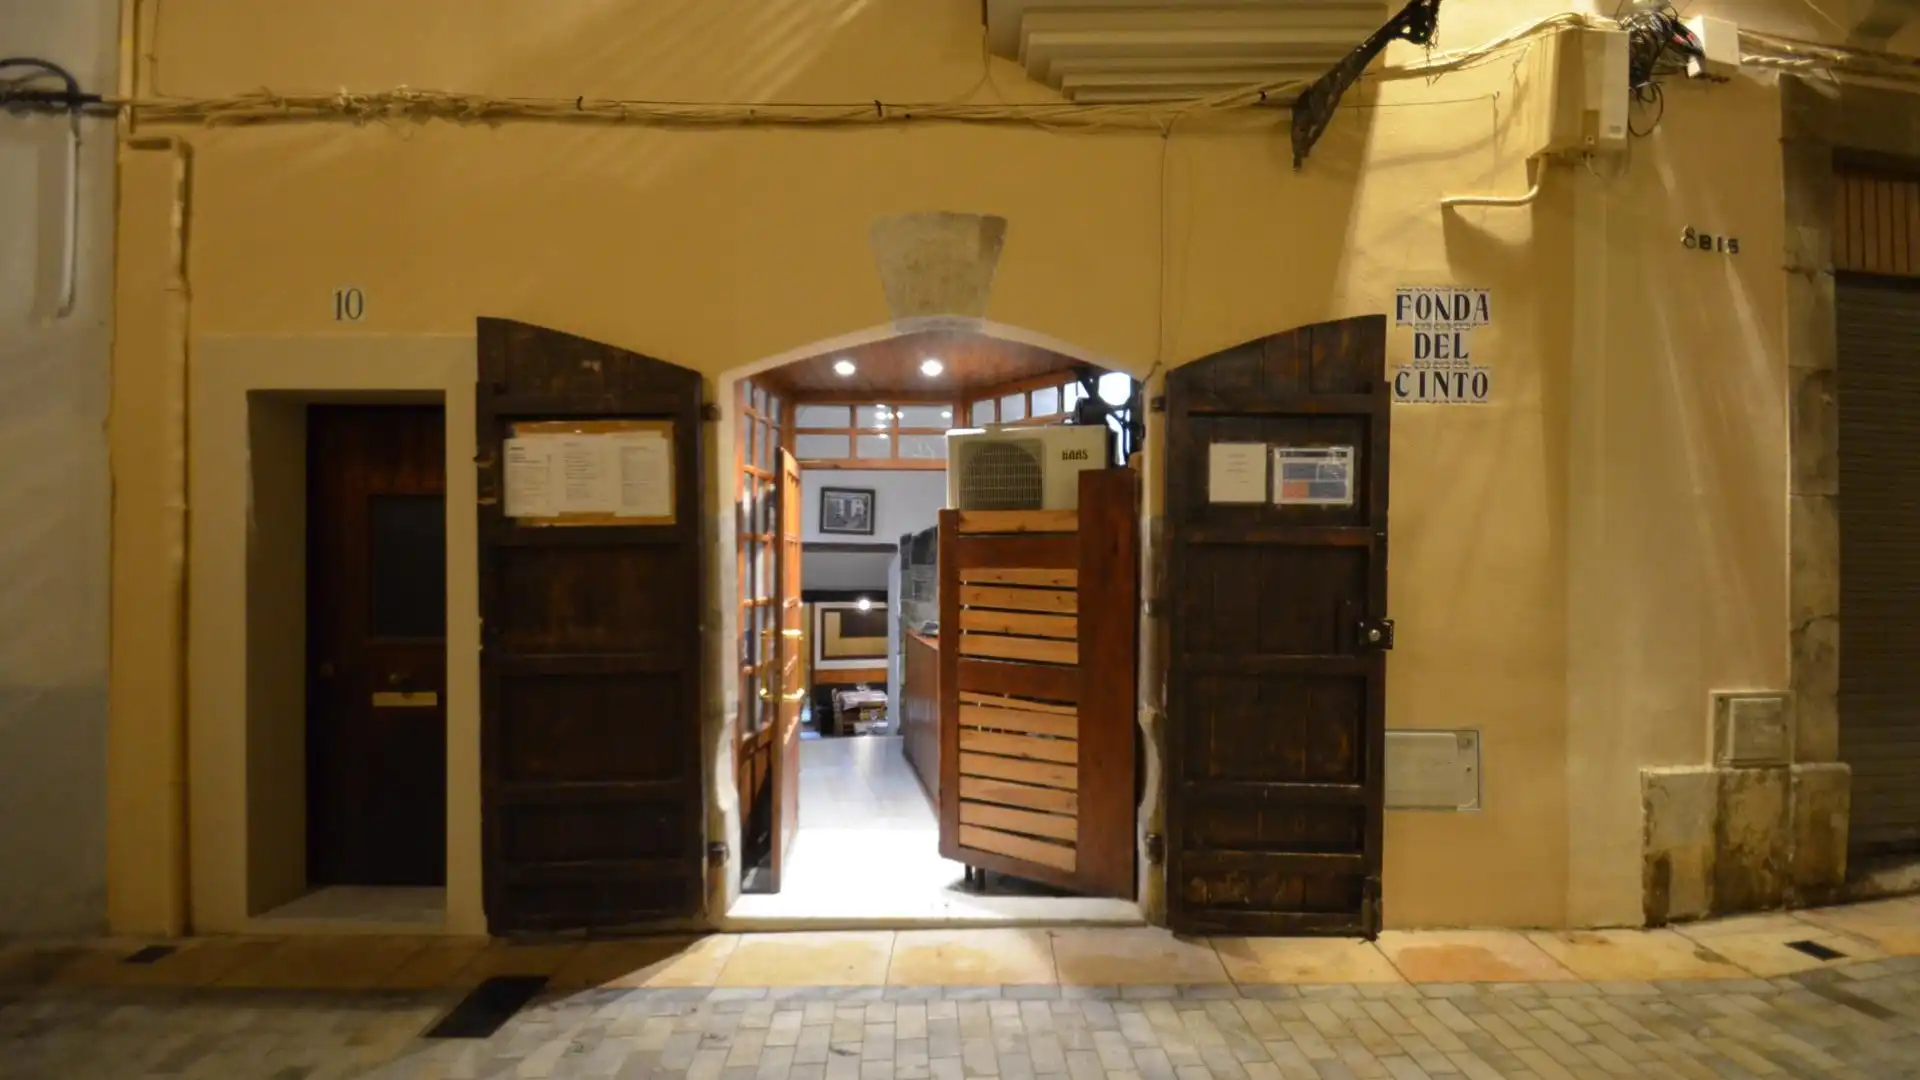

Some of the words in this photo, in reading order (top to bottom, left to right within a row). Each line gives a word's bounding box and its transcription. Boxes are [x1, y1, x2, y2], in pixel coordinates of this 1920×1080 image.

[335, 288, 363, 321] 10
[1396, 293, 1489, 321] FONDA
[1415, 332, 1469, 360] DEL
[1394, 371, 1488, 399] CINTO
